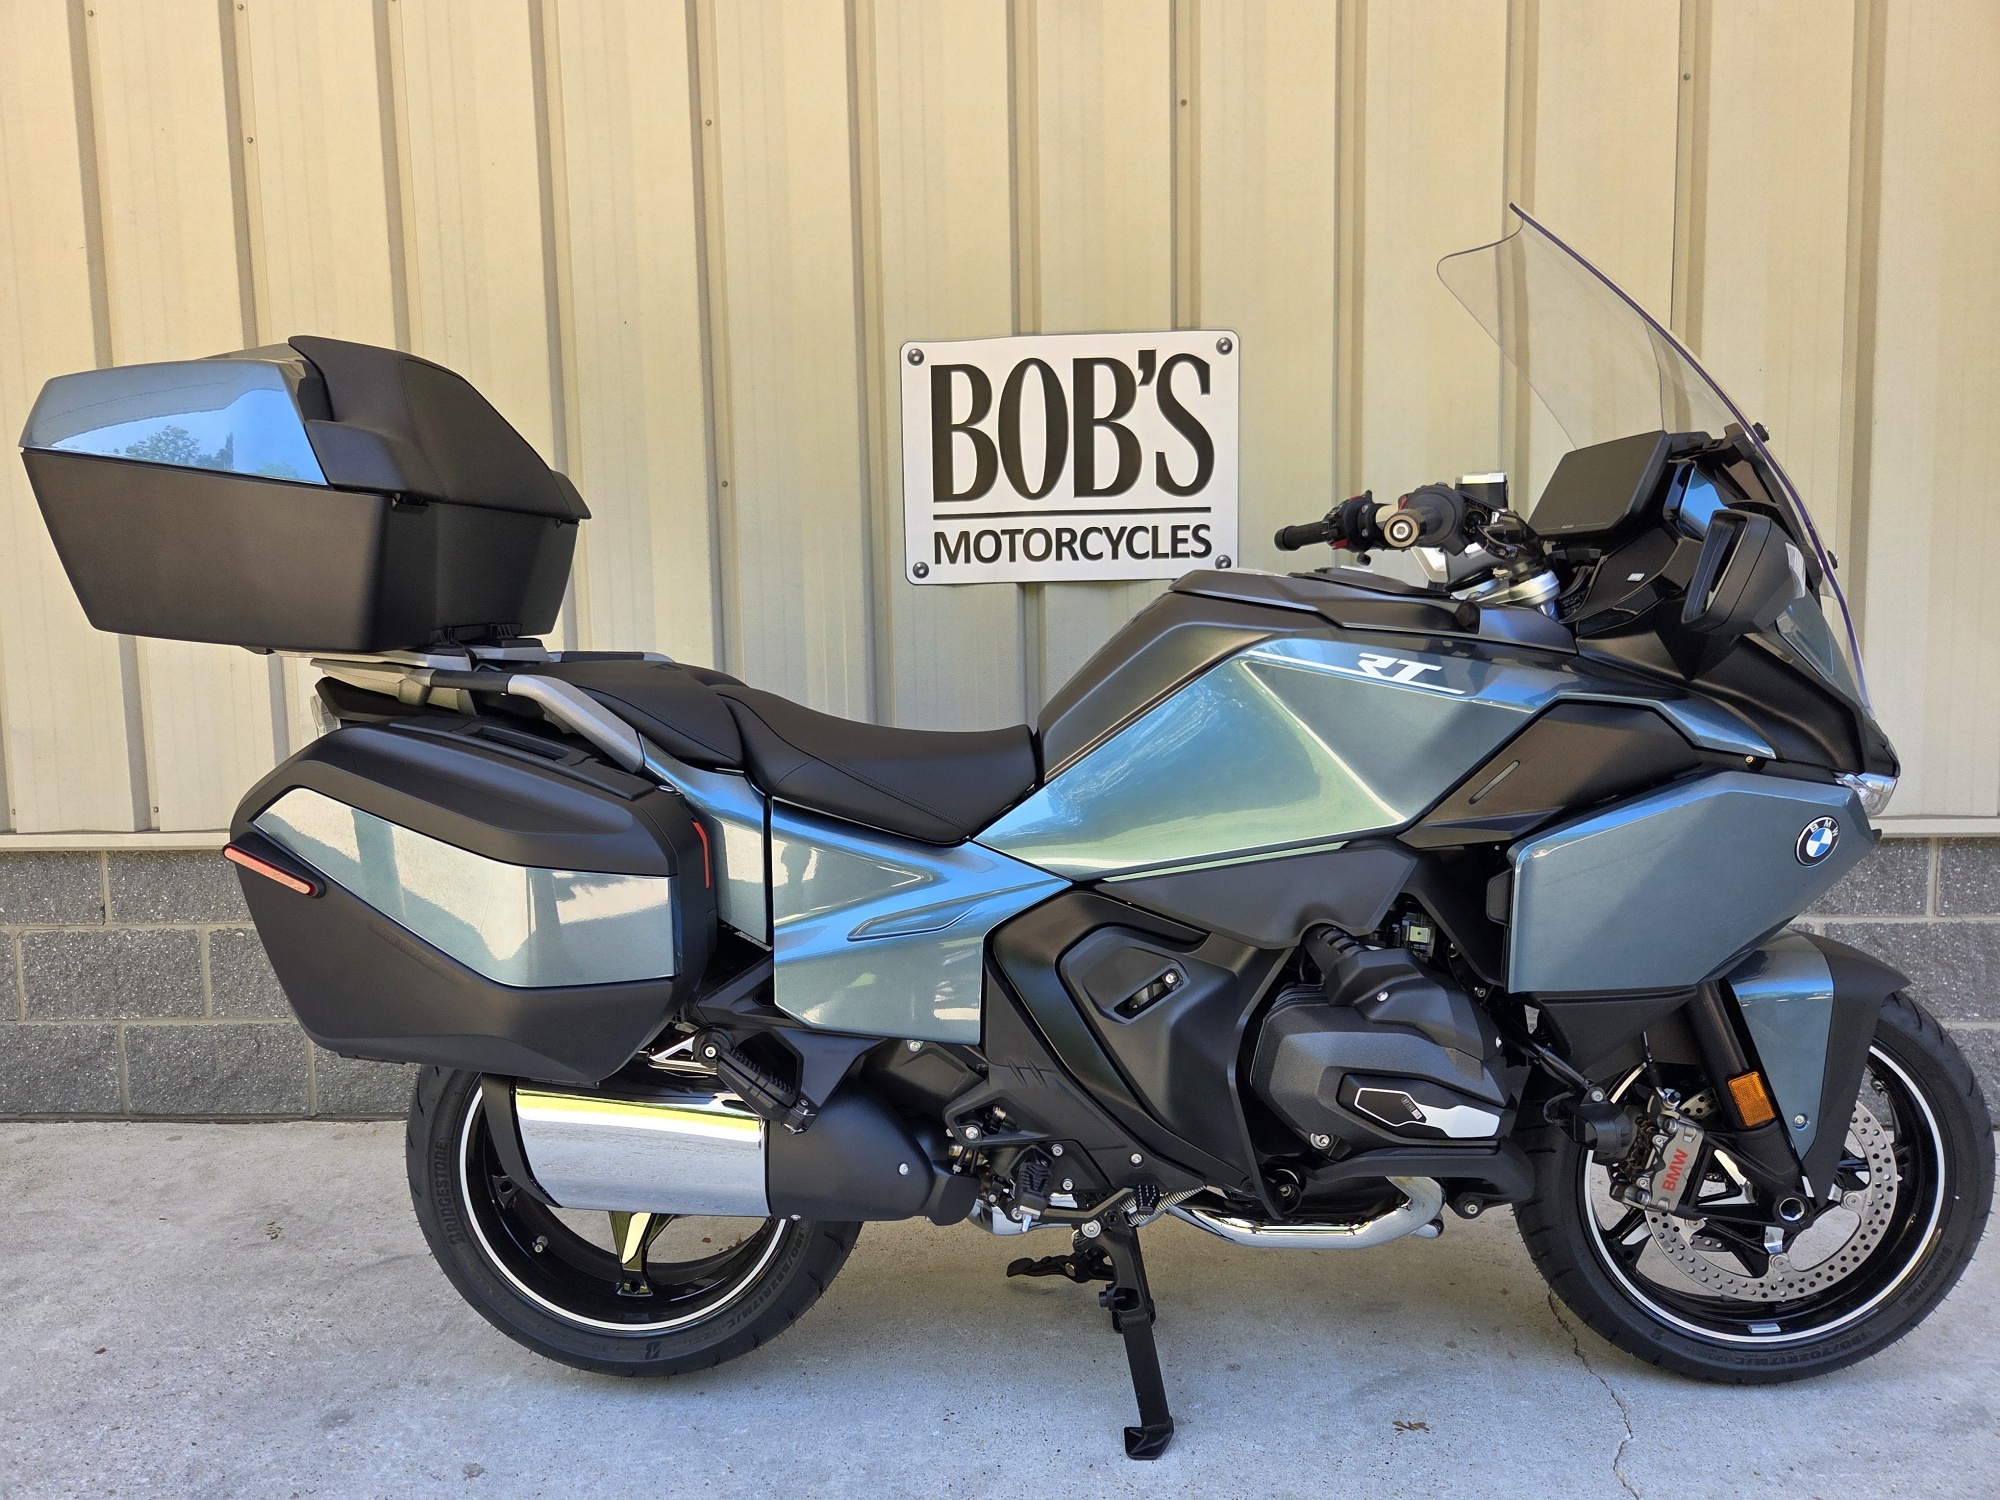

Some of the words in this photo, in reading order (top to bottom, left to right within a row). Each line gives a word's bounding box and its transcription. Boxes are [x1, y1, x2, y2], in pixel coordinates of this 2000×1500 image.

[930, 349, 1214, 502] BOB'S
[933, 524, 1212, 565] MOTORCYCLES
[1356, 652, 1443, 682] RT
[1809, 819, 1839, 837] BMW
[1661, 1146, 1689, 1192] BMW
[433, 1140, 466, 1246] BRIDGESTONE
